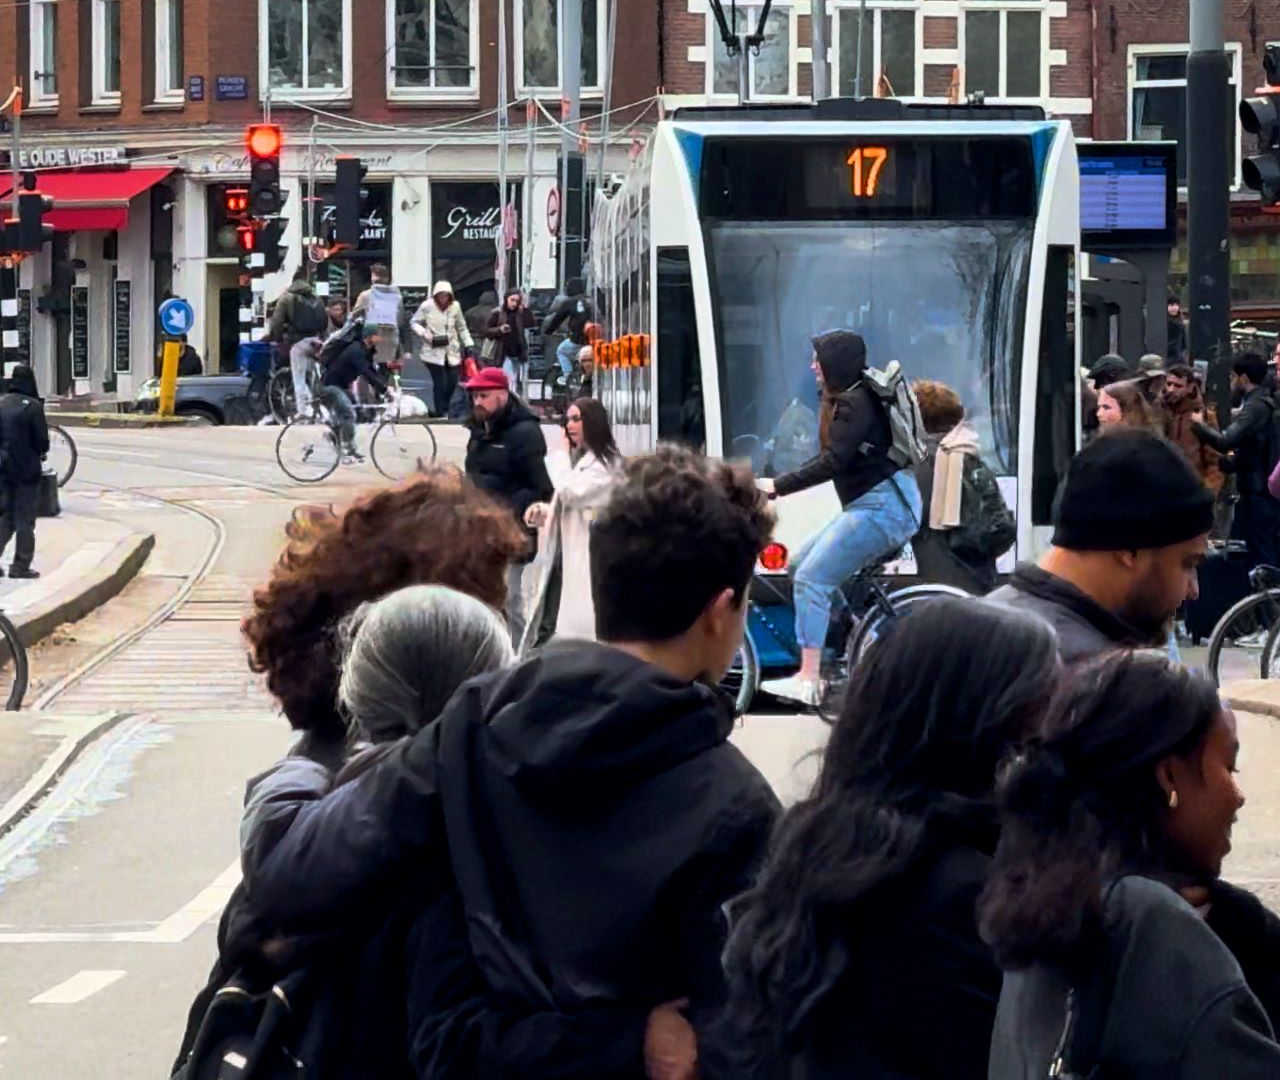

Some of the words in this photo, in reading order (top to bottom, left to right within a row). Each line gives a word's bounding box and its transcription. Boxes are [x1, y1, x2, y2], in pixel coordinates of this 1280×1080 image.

[30, 149, 65, 167] OUDE
[847, 147, 887, 196] 17
[441, 206, 500, 238] Grill
